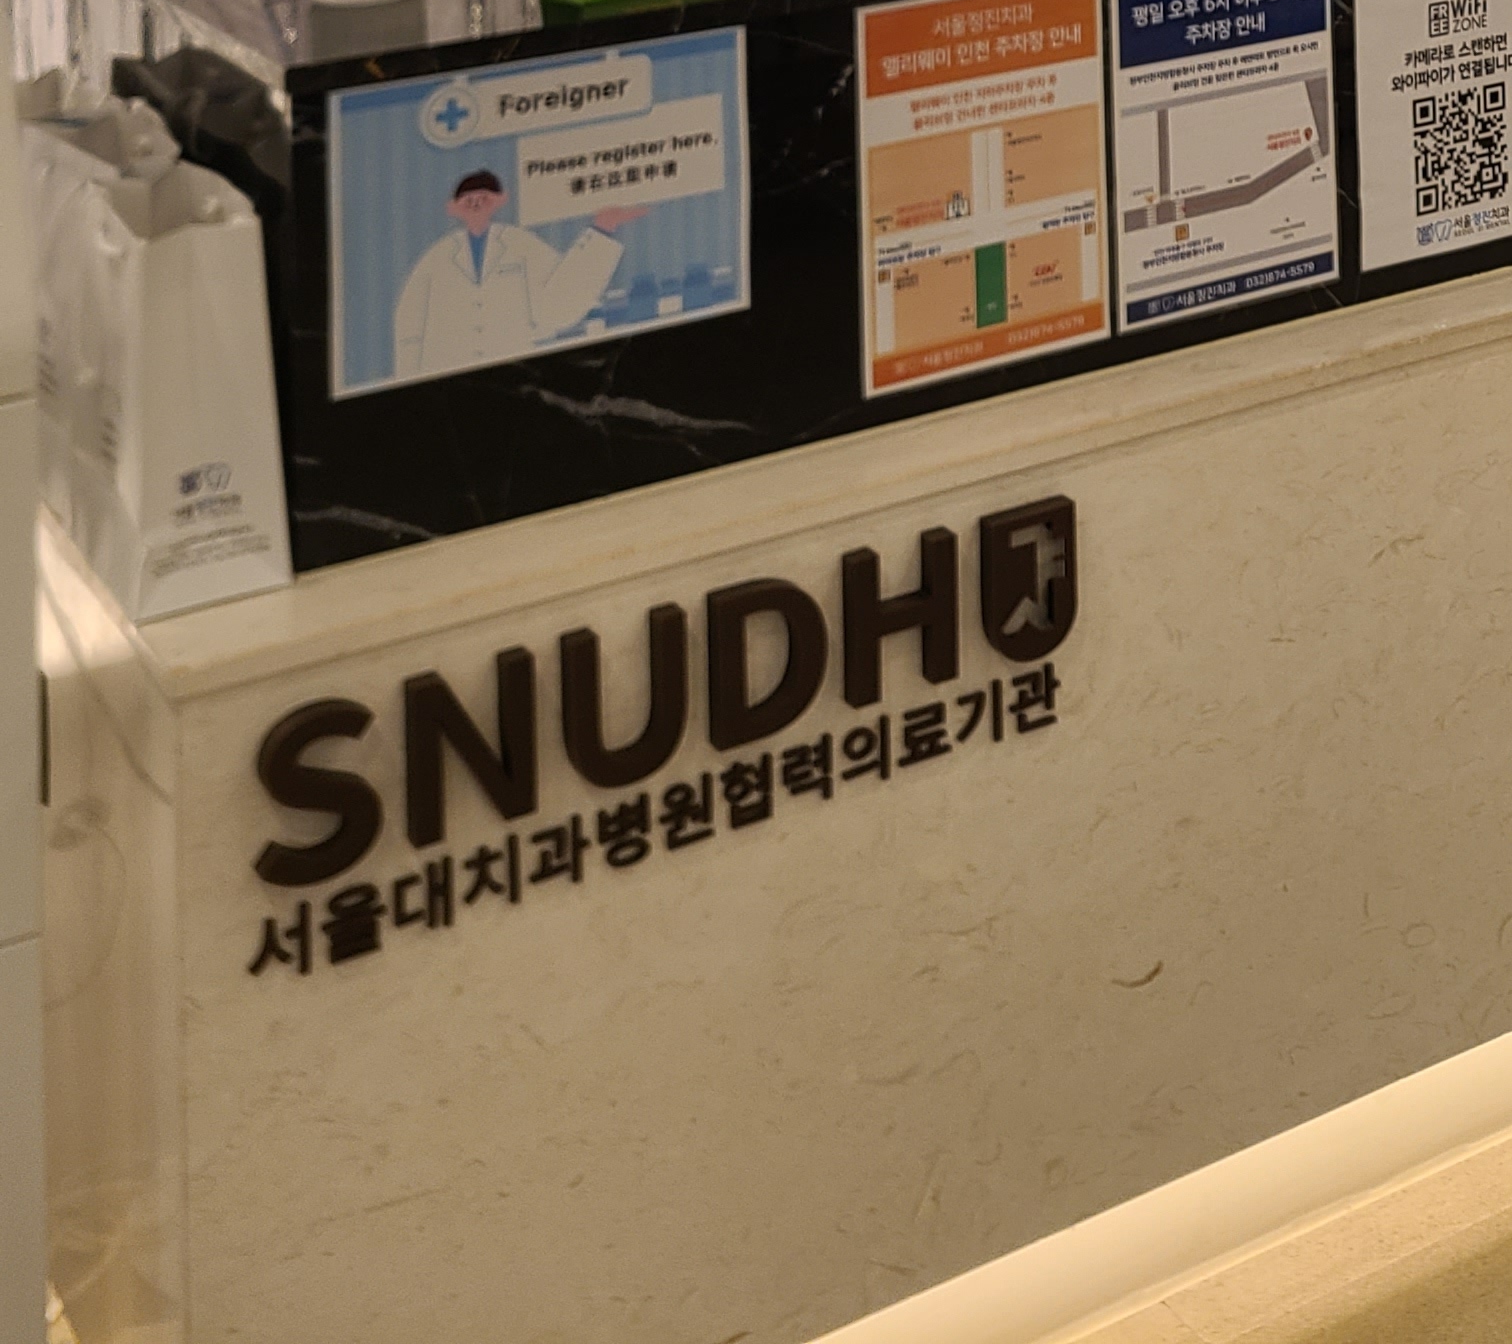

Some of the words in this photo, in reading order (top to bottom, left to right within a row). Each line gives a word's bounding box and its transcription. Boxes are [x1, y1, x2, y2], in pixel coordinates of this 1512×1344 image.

[932, 3, 1033, 38] 서울정진치과
[1131, 1, 1164, 27] 평일
[1185, 20, 1232, 45] 주차장
[1235, 12, 1266, 36] 안내
[1452, 14, 1487, 33] ZONE
[957, 40, 990, 66] 인천
[995, 29, 1044, 58] 주차장
[1049, 23, 1082, 47] 안내
[1405, 44, 1455, 68] 카메라로
[1458, 32, 1508, 57] 스캔하면
[1391, 64, 1455, 92] 와이파이가
[499, 75, 631, 118] Foreigner
[527, 152, 589, 178] Please
[593, 140, 667, 169] register
[671, 130, 719, 153] here.
[1454, 206, 1510, 228] 서울정진치과
[1176, 283, 1237, 309] 서울정진치과
[254, 526, 960, 890] SNUDH
[247, 662, 1064, 979] 서울대치과병원협력의료기관
